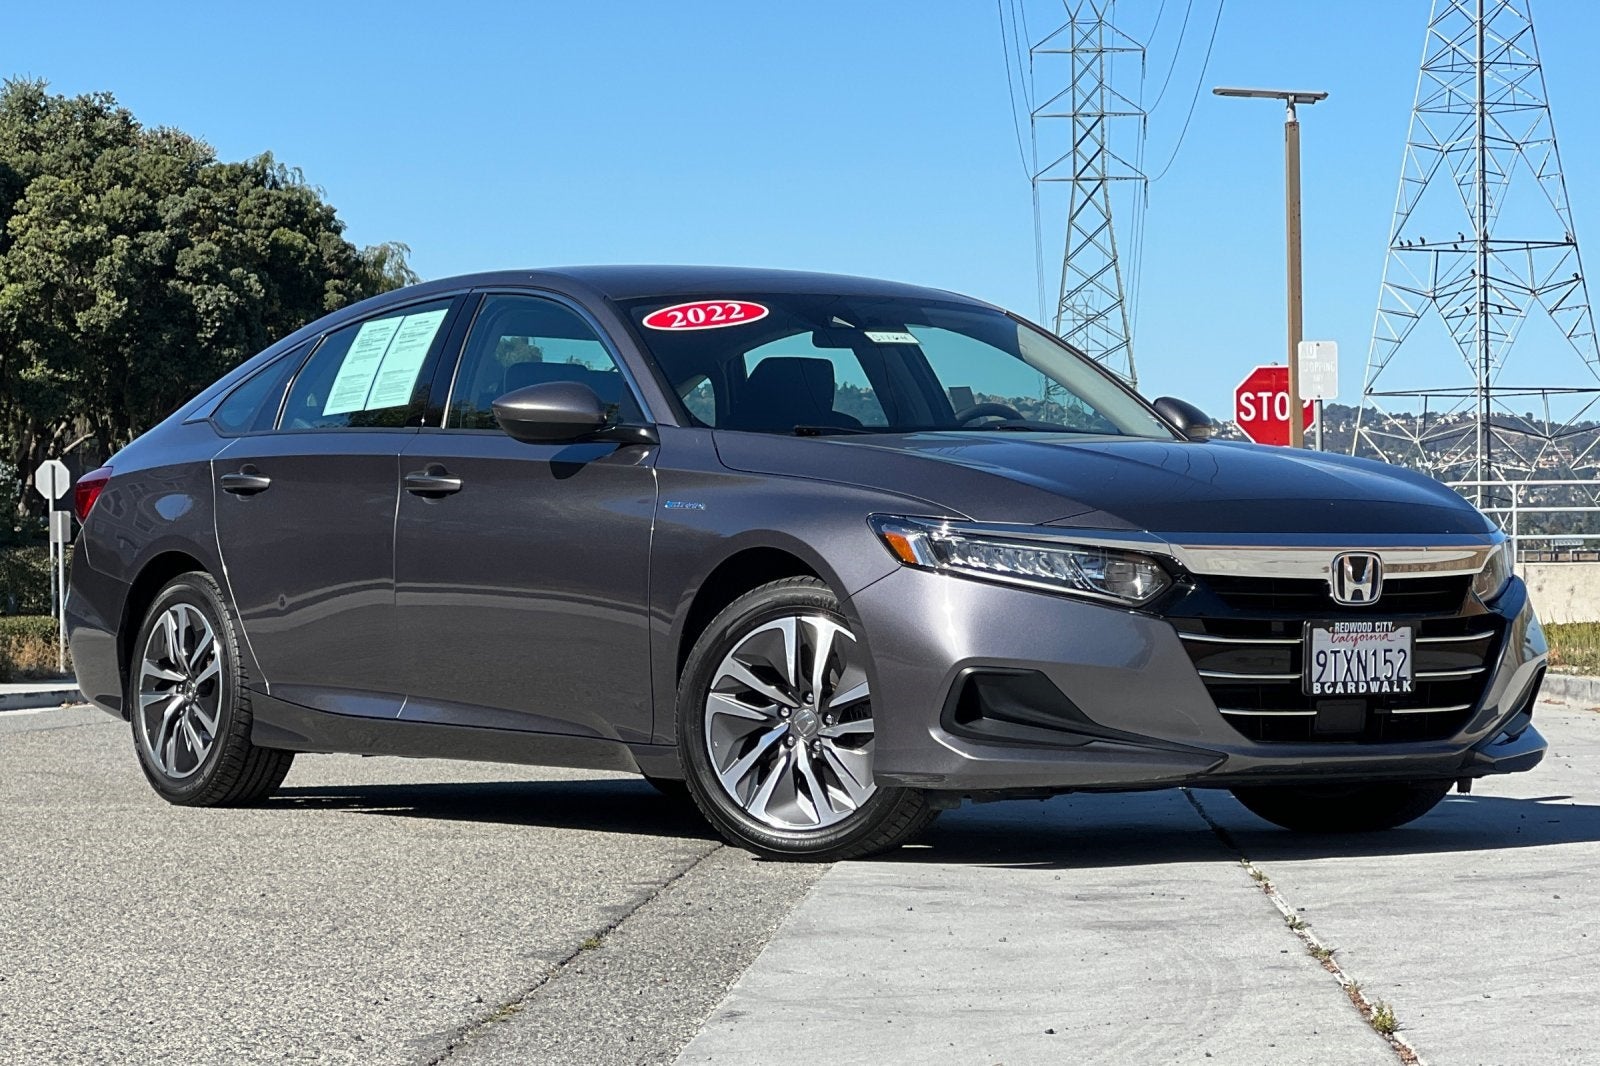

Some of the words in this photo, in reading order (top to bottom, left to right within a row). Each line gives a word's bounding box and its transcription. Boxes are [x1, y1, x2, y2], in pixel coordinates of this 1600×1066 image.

[667, 303, 744, 328] 2022
[1239, 391, 1310, 421] STO
[1331, 631, 1395, 647] California
[1334, 622, 1372, 633] REDWOOD
[1375, 621, 1394, 632] CITY
[1315, 648, 1407, 682] 9TXN152
